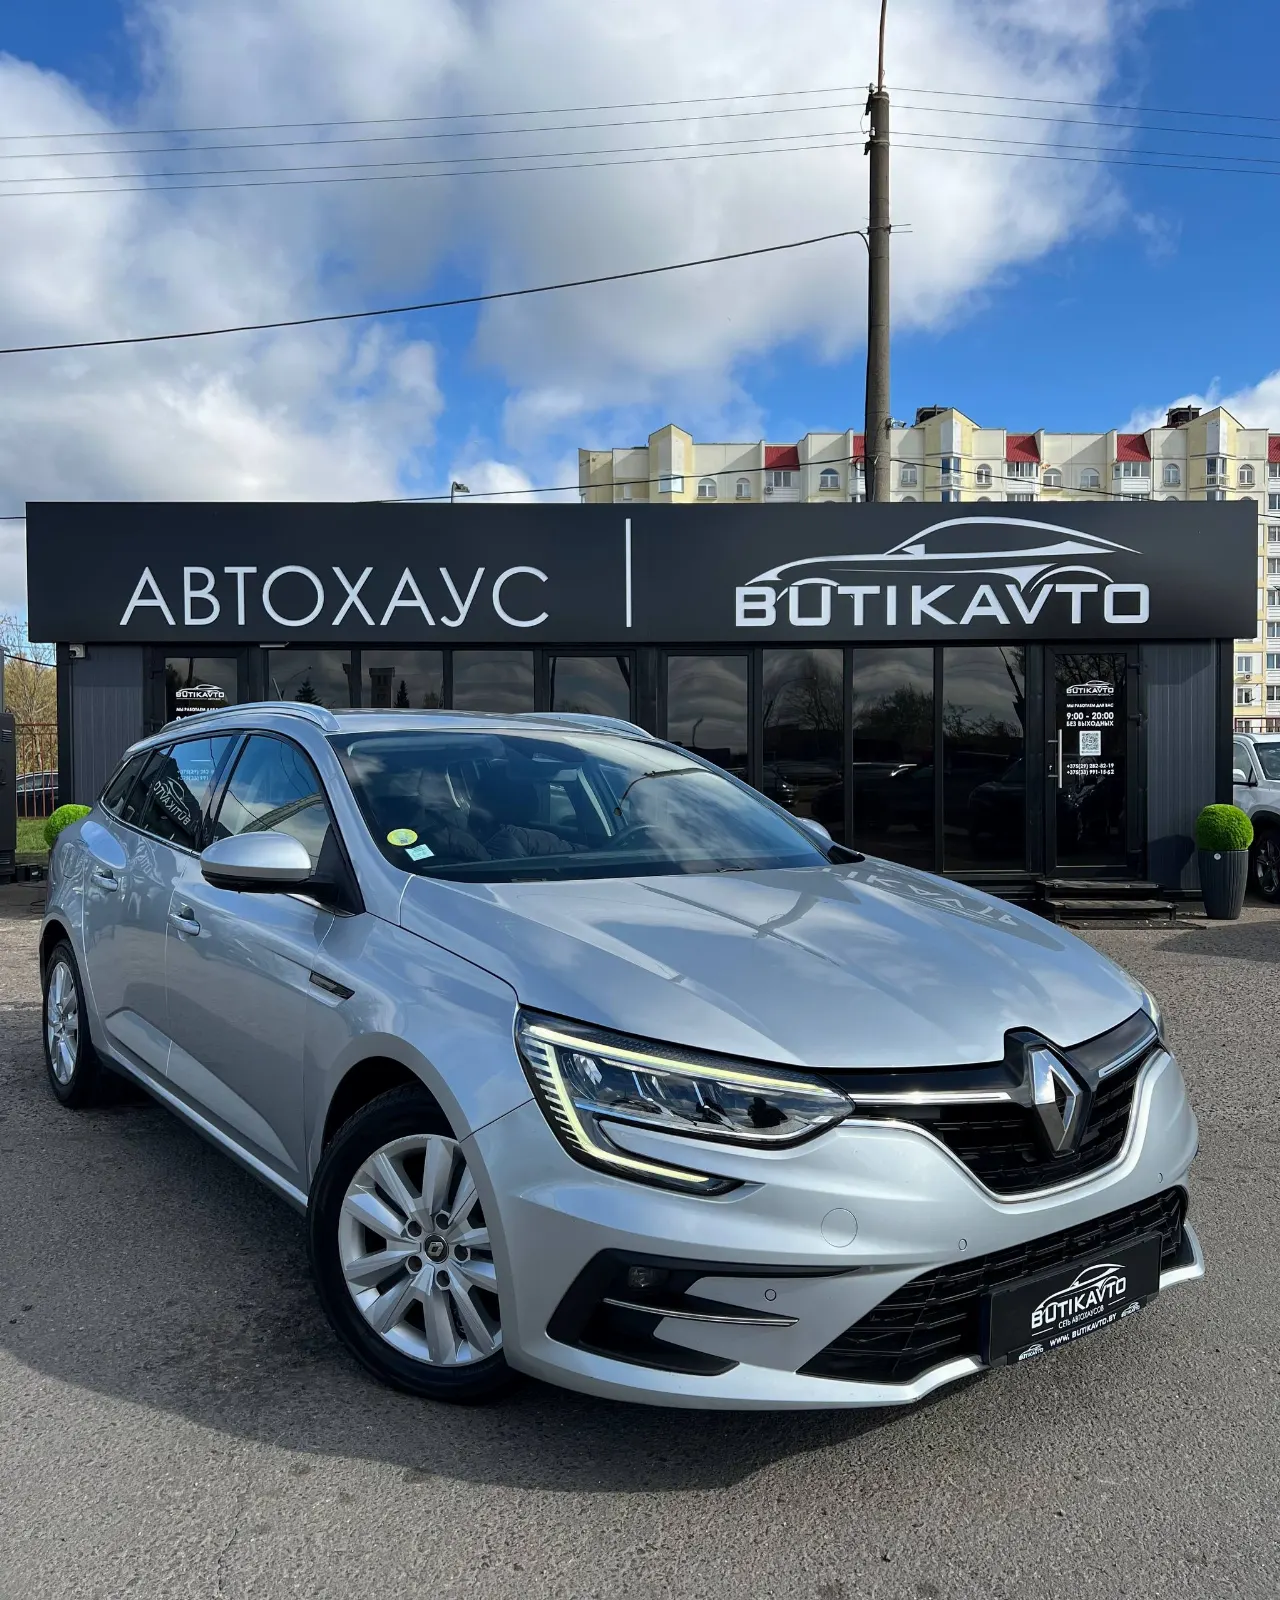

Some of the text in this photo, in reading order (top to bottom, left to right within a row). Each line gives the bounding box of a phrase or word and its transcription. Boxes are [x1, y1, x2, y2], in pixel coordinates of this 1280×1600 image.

[119, 565, 549, 628] АВТОХАУС
[735, 581, 1150, 627] BUTIKAVTO
[1066, 712, 1084, 720] 9:00
[1091, 712, 1114, 720] 20:00
[1031, 1276, 1127, 1329] BUTIKAVTO
[1058, 1318, 1072, 1329] СЕТЬ
